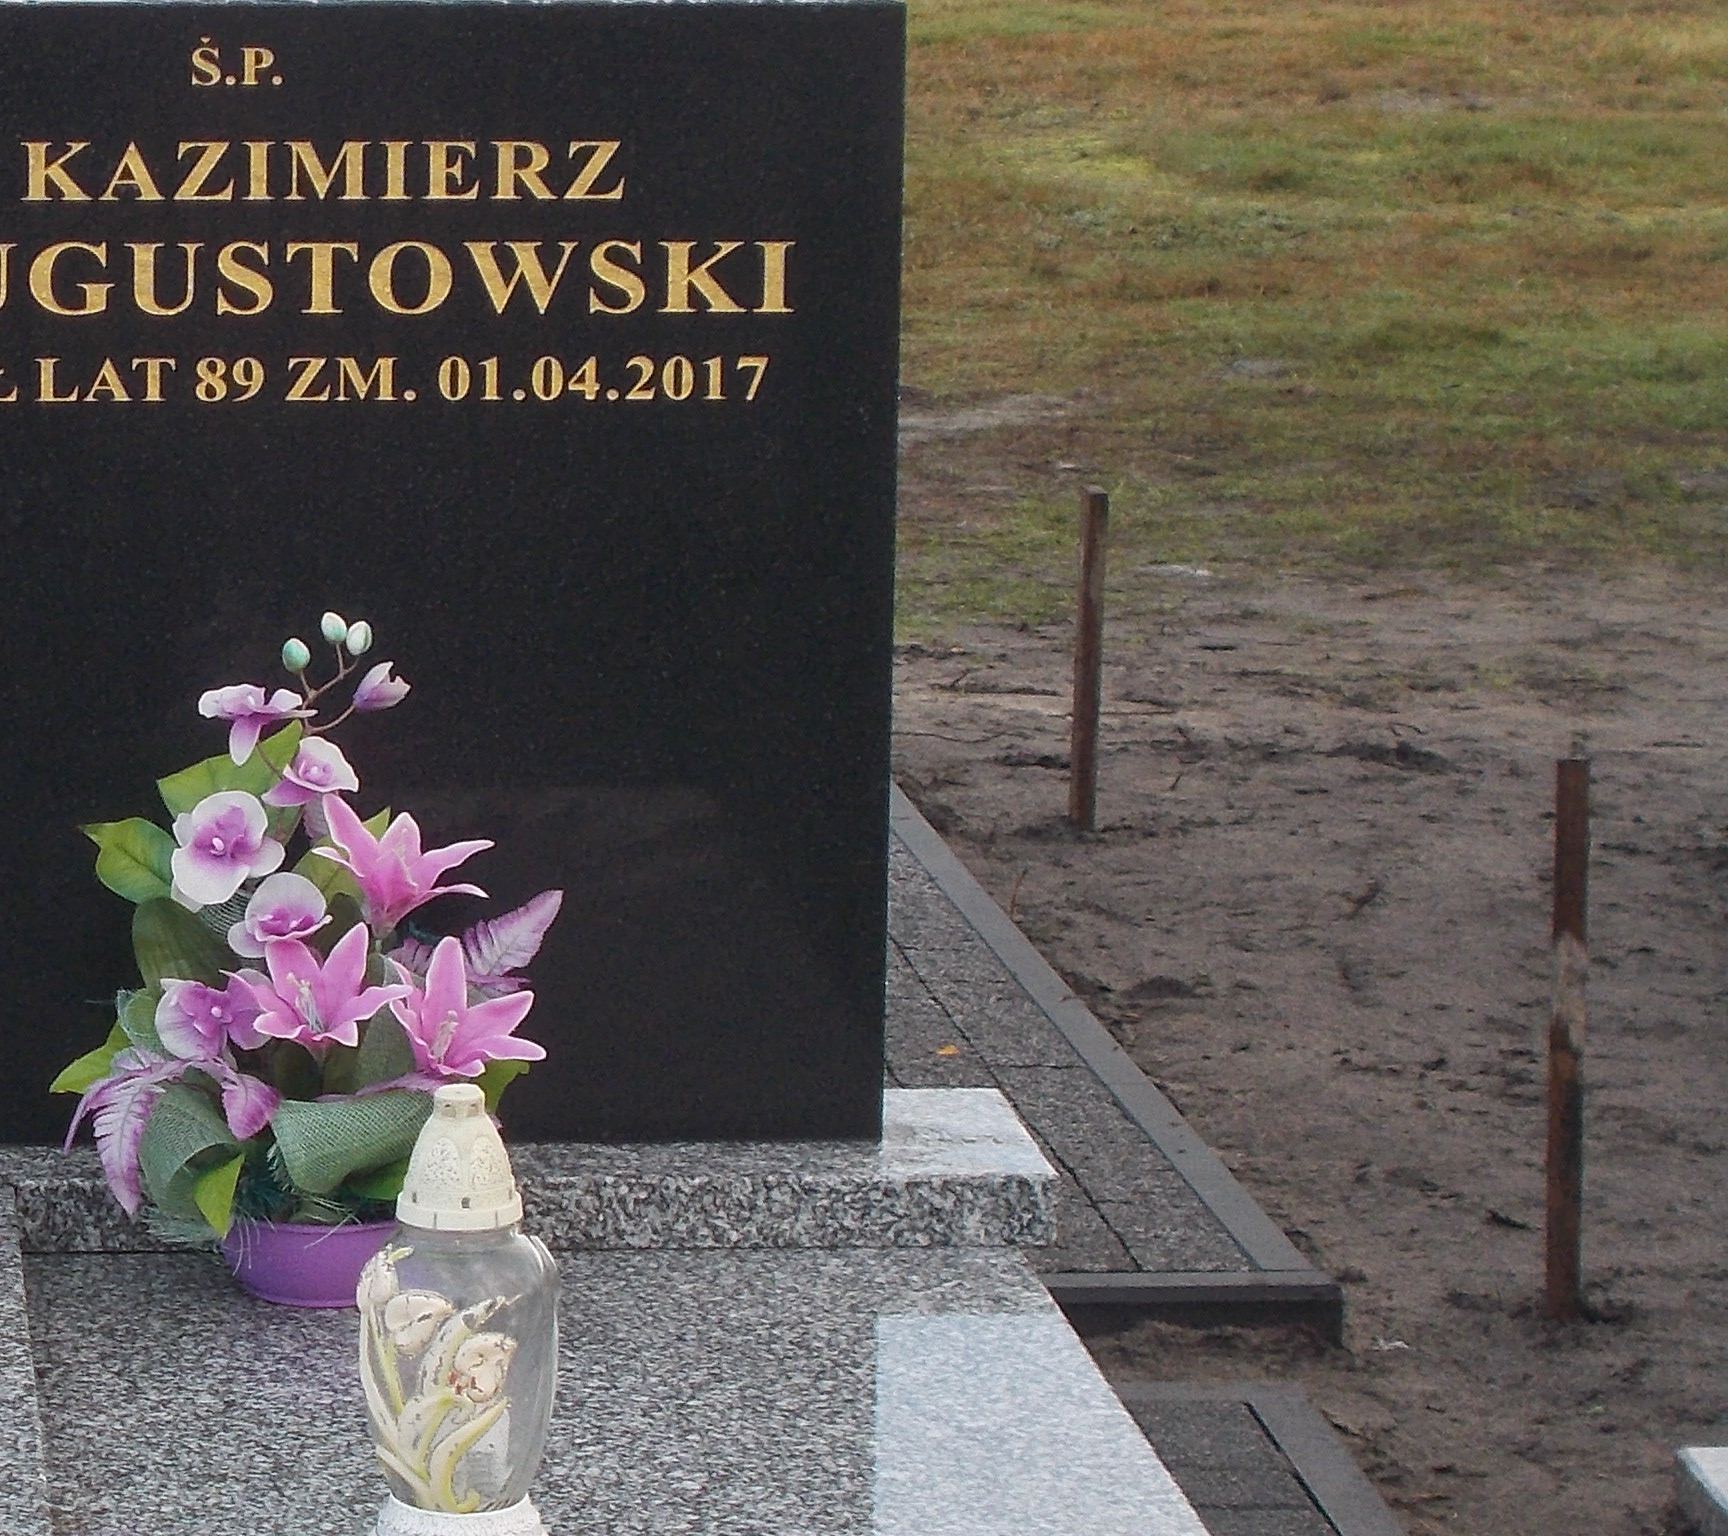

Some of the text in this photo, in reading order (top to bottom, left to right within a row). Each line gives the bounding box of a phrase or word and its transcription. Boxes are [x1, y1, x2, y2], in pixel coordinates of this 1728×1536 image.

[19, 139, 626, 202] KAZIMIERZ
[34, 357, 176, 402] LAT
[195, 357, 265, 402] 89
[287, 356, 417, 402] ZM.
[437, 355, 769, 401] 01.04.2017
